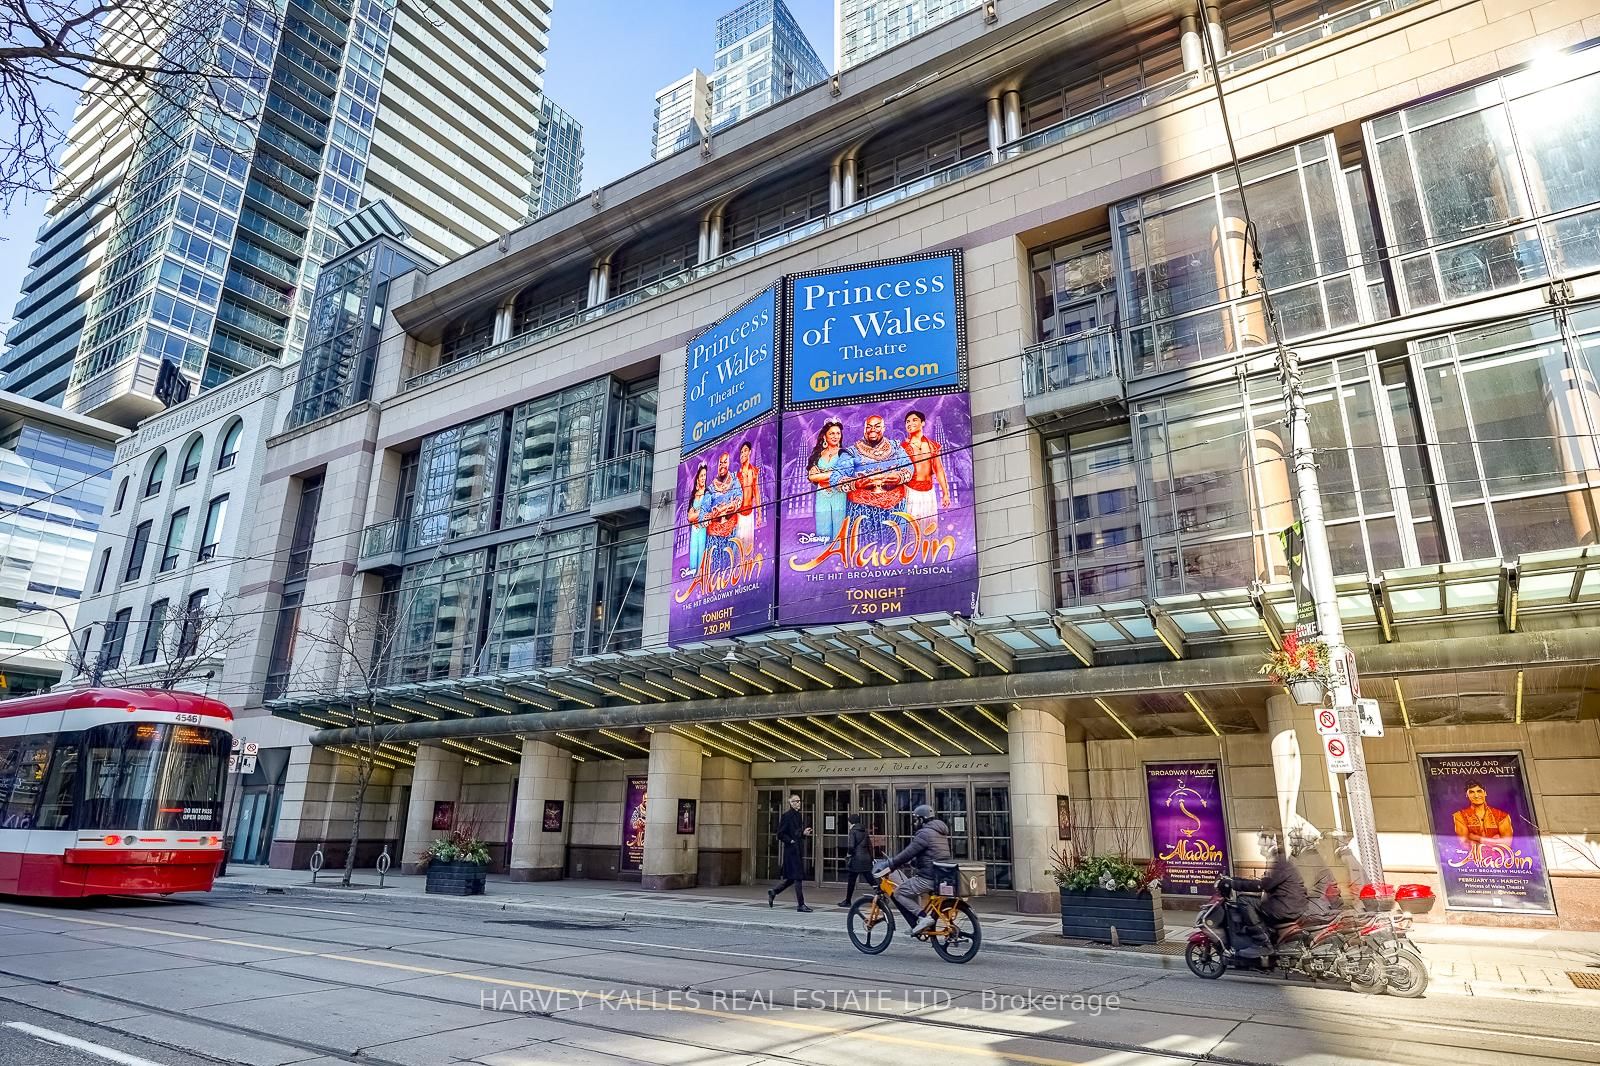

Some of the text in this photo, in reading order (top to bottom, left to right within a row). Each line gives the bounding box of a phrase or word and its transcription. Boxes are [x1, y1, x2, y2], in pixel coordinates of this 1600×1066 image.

[803, 274, 945, 311] Princess
[692, 309, 769, 370] Princess
[802, 307, 945, 346] of Wales
[839, 341, 907, 360] Theatre
[690, 344, 768, 402] of Wales
[809, 361, 939, 392] mirvish.com
[708, 380, 745, 408] Theatre
[692, 393, 761, 441] mirvish.com
[788, 511, 956, 572] Aladdin
[797, 532, 831, 544] Disney
[675, 537, 763, 603] Aladdin
[806, 565, 953, 582] THE HIT BROADWAY MUSICAL
[682, 602, 692, 611] THE
[703, 590, 734, 605] BROADWAY
[734, 583, 760, 595] MUSICAL
[846, 587, 907, 601] TONIGHT
[702, 606, 734, 623] TONIGHT
[851, 602, 901, 615] 7.30 PM
[703, 621, 731, 636] 7.30 PM
[175, 713, 198, 723] 4546
[790, 760, 990, 774] The Princess of Wales Theatre
[1159, 839, 1223, 861] Aladdin
[1447, 843, 1533, 869] Aladdin
